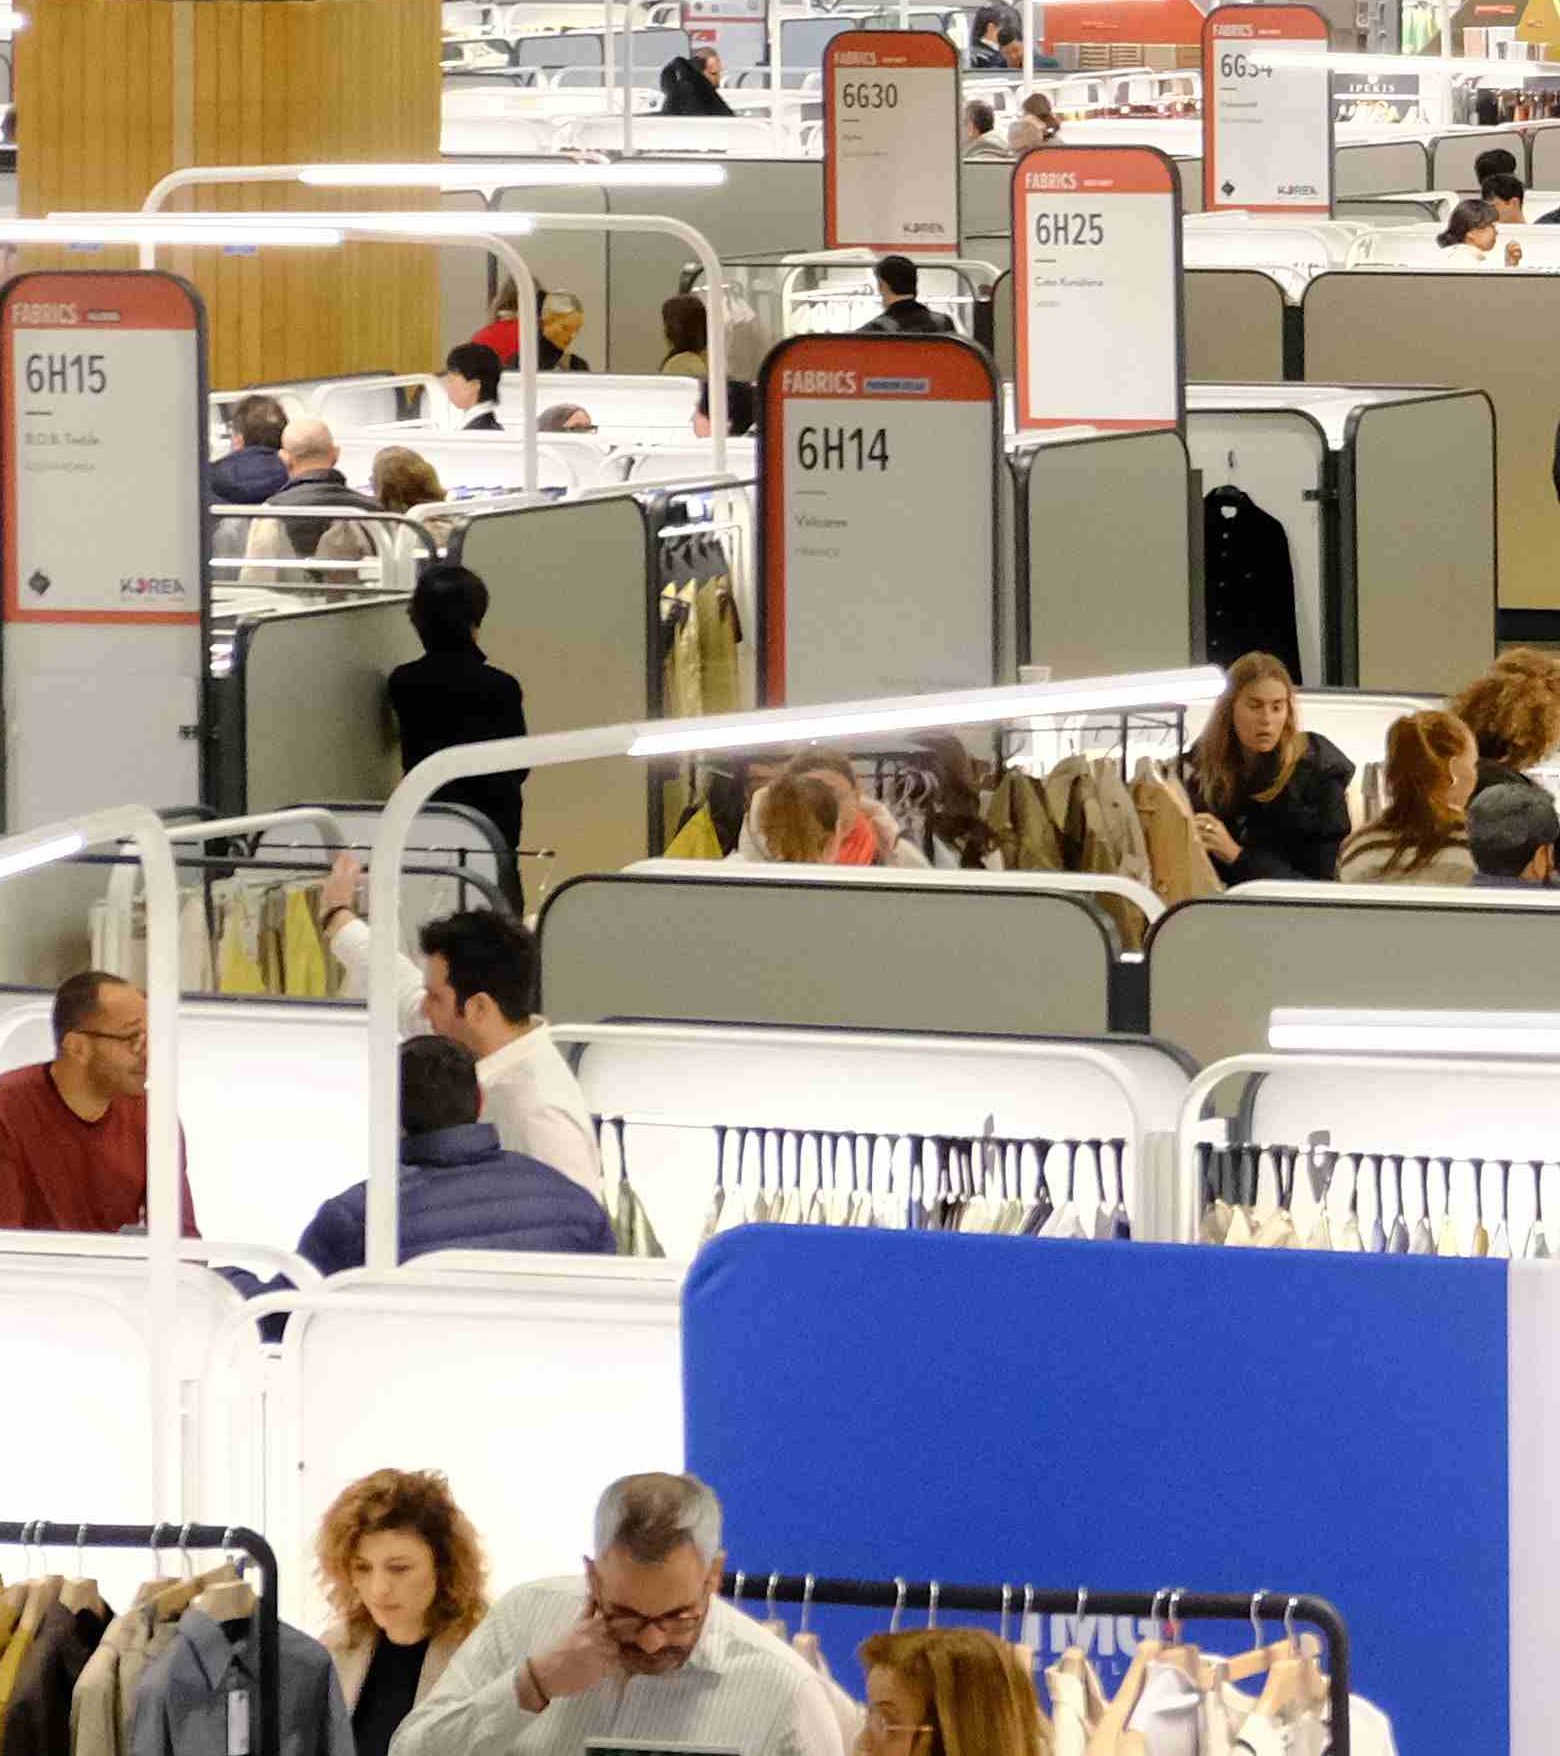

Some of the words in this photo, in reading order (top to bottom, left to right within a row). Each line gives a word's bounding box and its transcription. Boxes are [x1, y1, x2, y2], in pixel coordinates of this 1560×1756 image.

[1212, 24, 1254, 37] FABRICS
[842, 83, 898, 109] 6G30
[1025, 172, 1078, 189] FABRICS
[1034, 212, 1104, 246] 6H25
[11, 302, 78, 325] FABRICS
[26, 354, 108, 396] 6H15
[781, 369, 857, 395] FABRICS
[797, 425, 890, 471] 6H14
